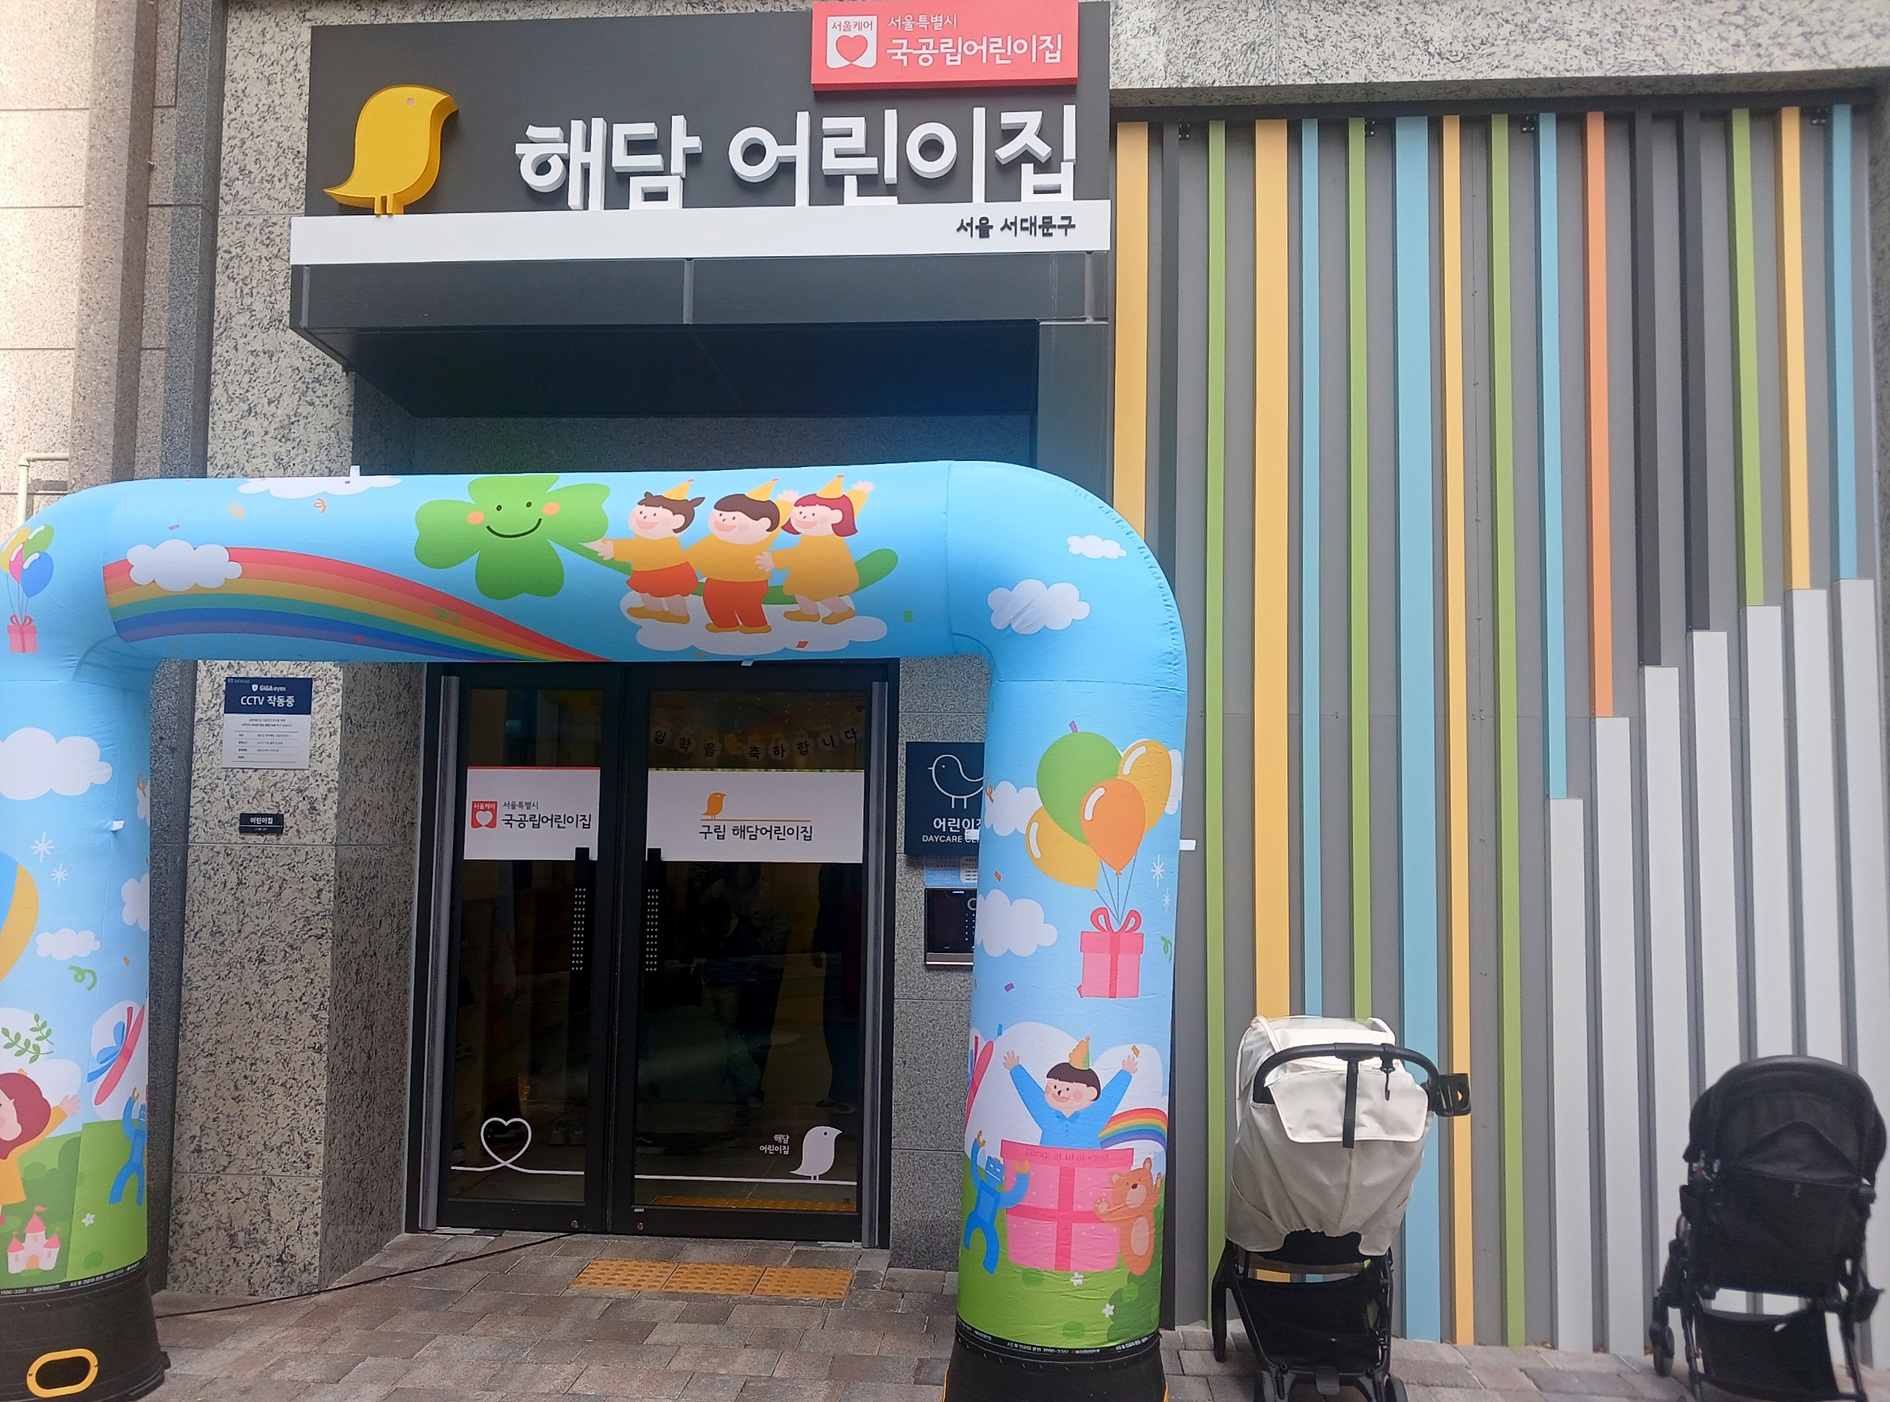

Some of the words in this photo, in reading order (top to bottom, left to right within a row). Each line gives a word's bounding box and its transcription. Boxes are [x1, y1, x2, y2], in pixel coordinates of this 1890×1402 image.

[831, 20, 873, 32] 서울케어
[888, 14, 957, 31] 서울특별시
[886, 33, 1063, 67] 국공립어린이집
[515, 113, 702, 211] 해담
[728, 104, 1076, 207] 어린이집
[956, 216, 994, 239] 서울
[1000, 215, 1076, 237] 서대문구
[240, 696, 265, 706] CCTV
[267, 695, 295, 708] 작동중
[654, 729, 717, 758] 입학을
[750, 727, 858, 761] 축하합니다
[502, 800, 539, 810] 서울특별시
[250, 817, 274, 825] 어린이집
[501, 813, 592, 829] 국공립어린이집
[699, 824, 726, 840] 구립
[731, 824, 813, 841] 해담어린이집
[922, 834, 963, 843] DAYCARE
[773, 1134, 790, 1144] 해담
[759, 1144, 790, 1155] 어린이집
